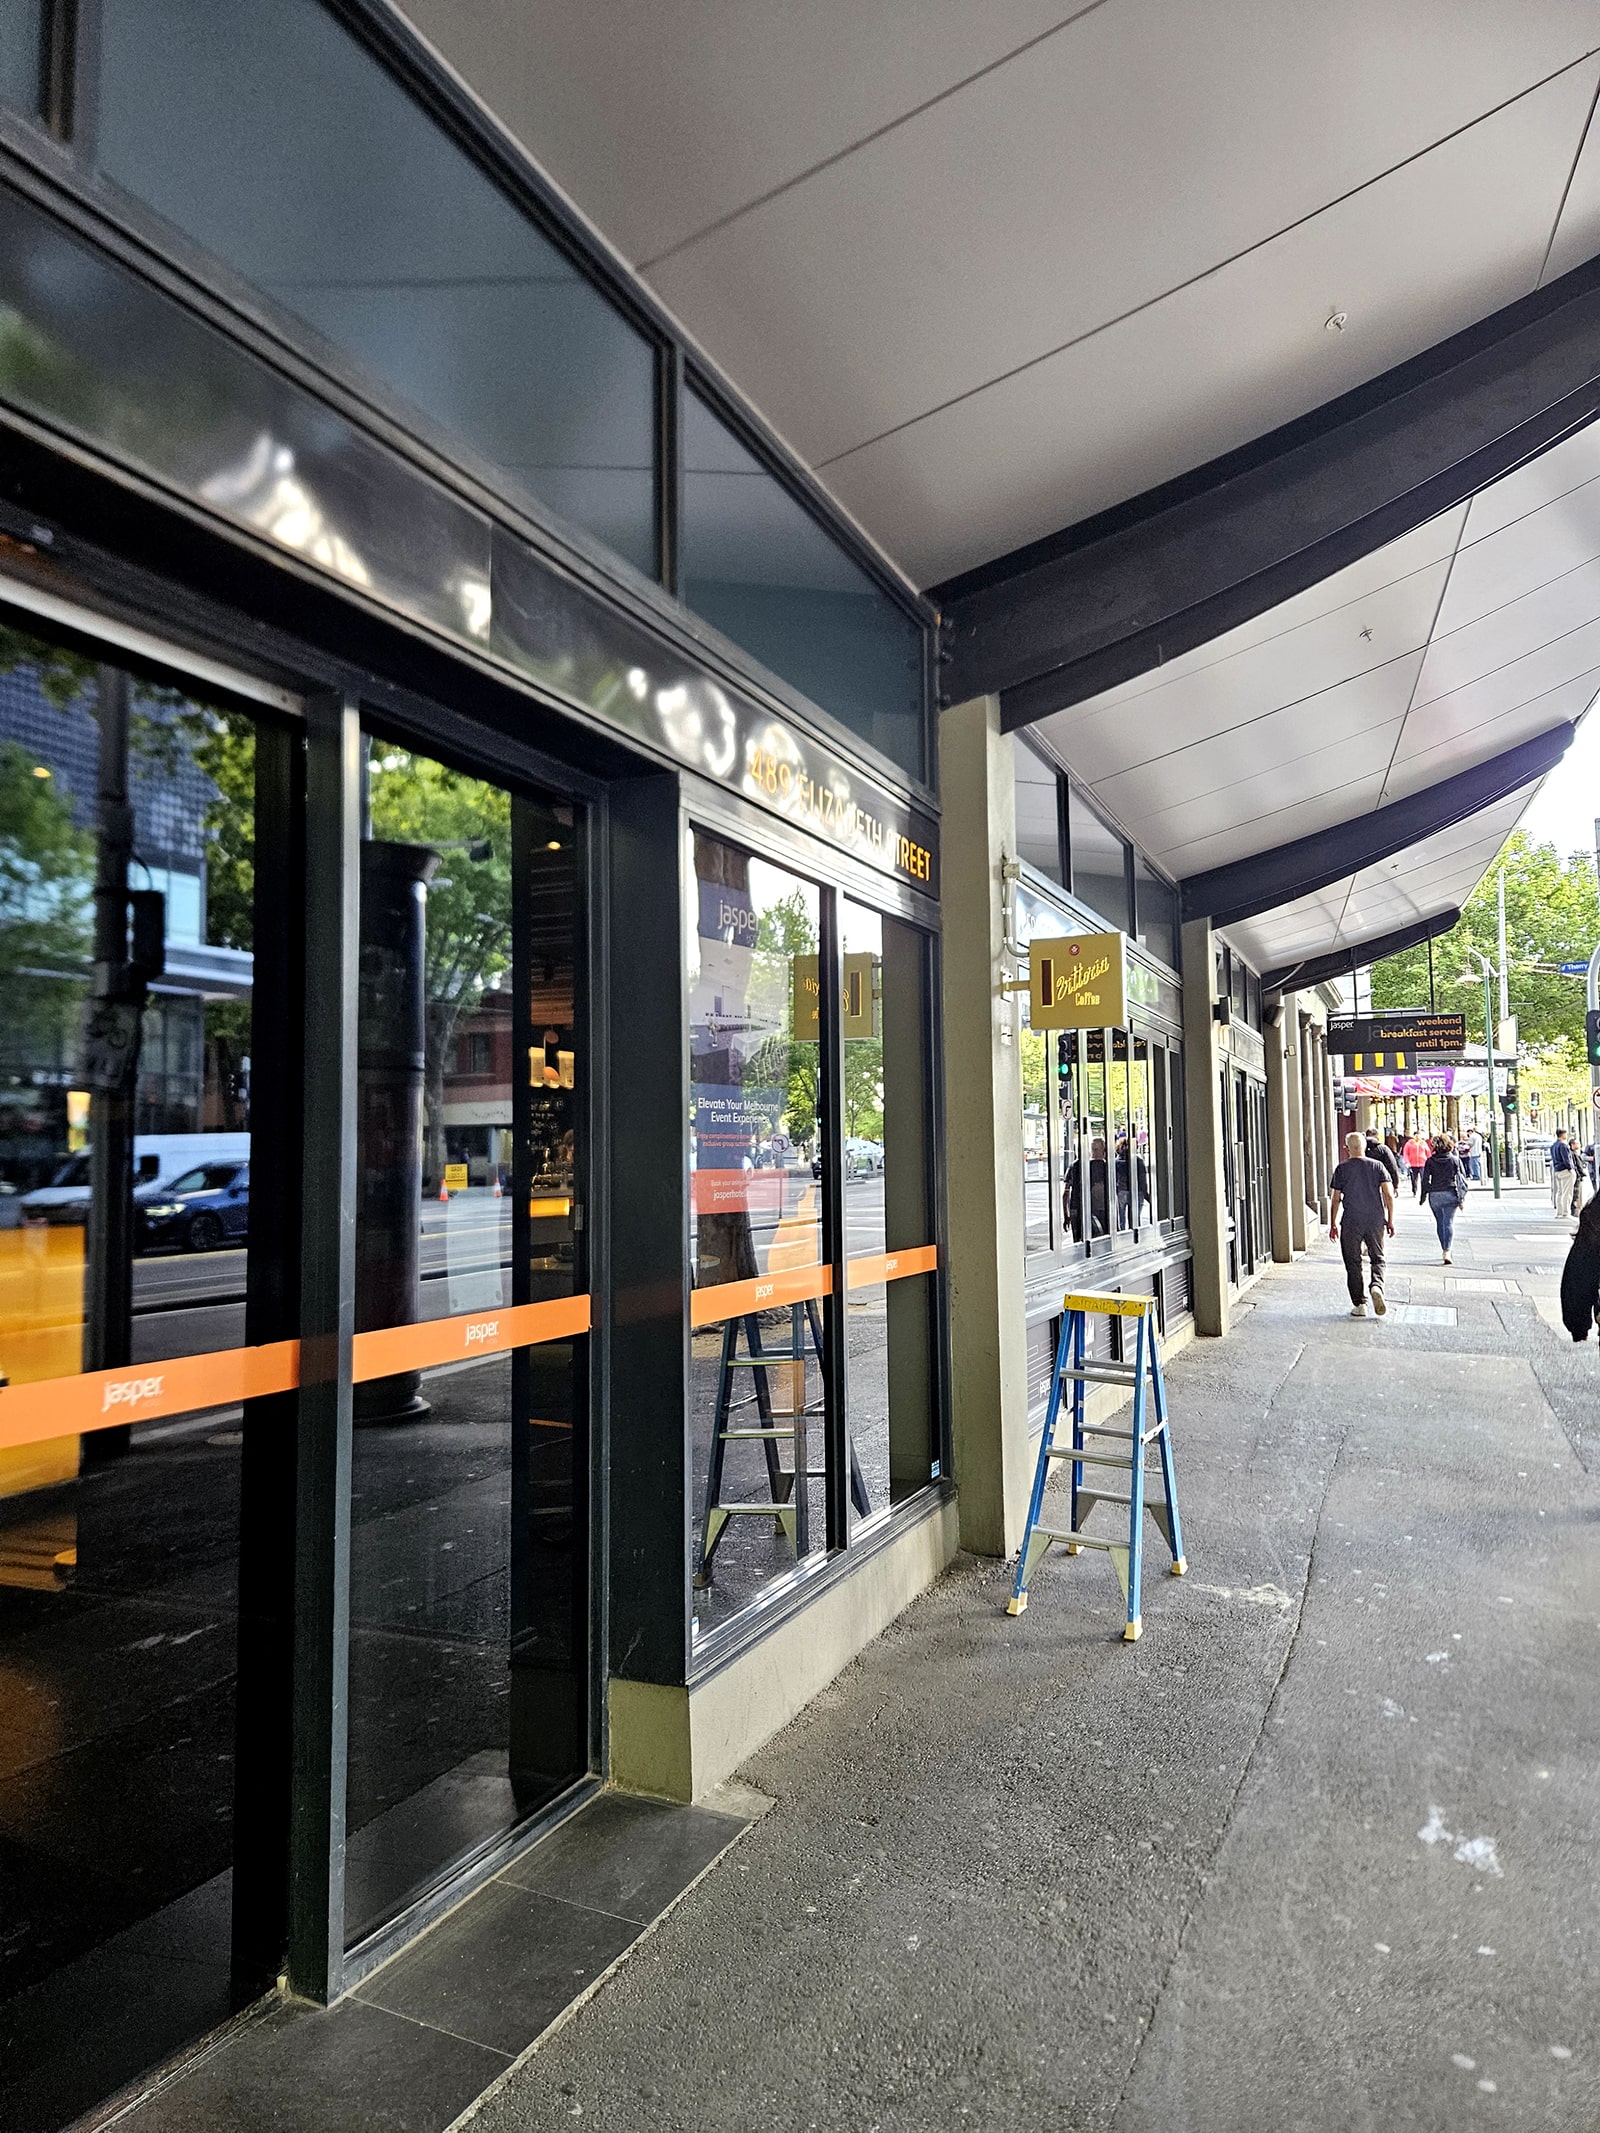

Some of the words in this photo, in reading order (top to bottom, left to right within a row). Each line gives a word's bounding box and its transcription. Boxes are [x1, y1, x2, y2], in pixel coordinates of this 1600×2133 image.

[751, 749, 791, 800] 489
[886, 828, 931, 881] STREET
[1075, 992, 1100, 1006] Coffee
[1329, 1021, 1354, 1031] jasper
[1416, 1016, 1462, 1026] weekend
[1380, 1028, 1428, 1038] breakfast
[1429, 1026, 1463, 1036] served
[1415, 1039, 1438, 1048] until
[1439, 1038, 1463, 1049] 1pm.
[698, 1097, 725, 1109] Elevate
[726, 1099, 742, 1110] Your
[743, 1101, 779, 1112] Melbourne
[711, 1111, 732, 1123] Event
[755, 1284, 774, 1302] jasper
[465, 1321, 499, 1346] jasper
[101, 1376, 164, 1413] jasper
